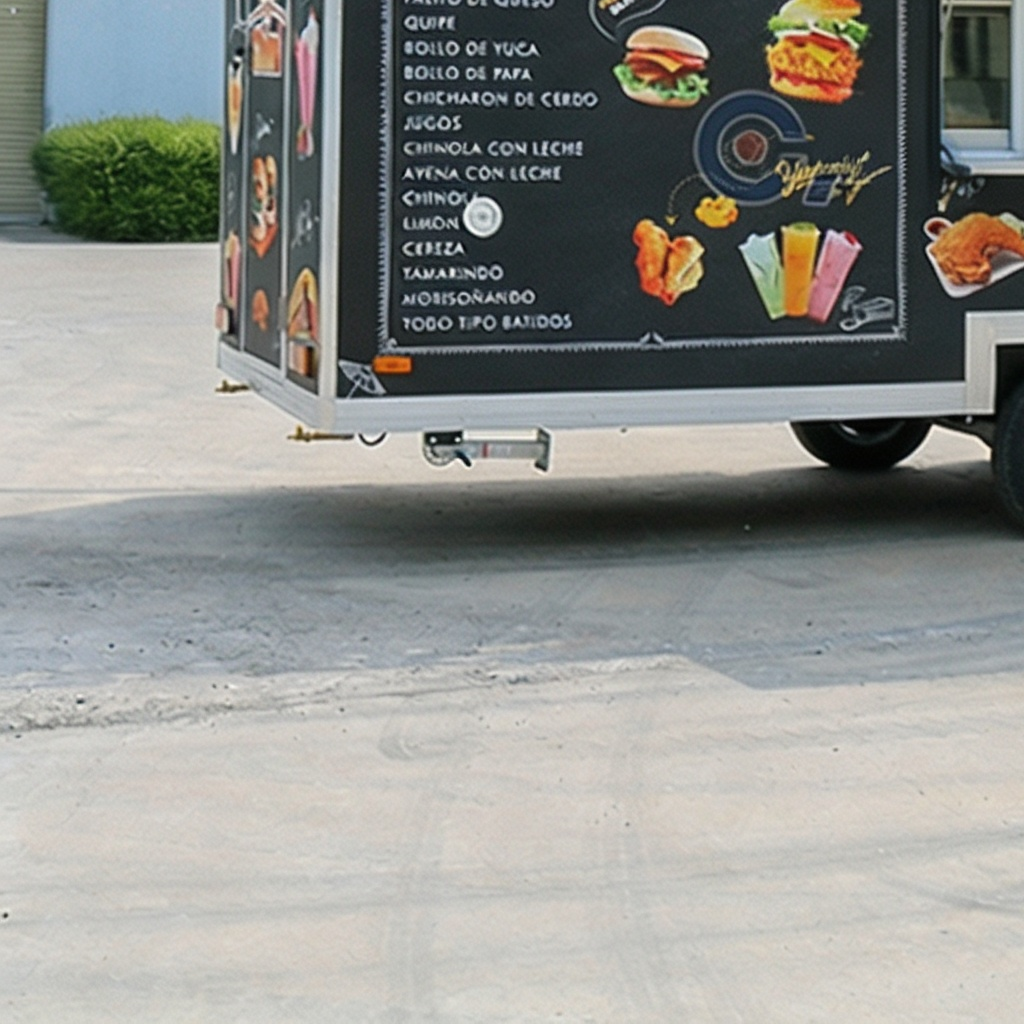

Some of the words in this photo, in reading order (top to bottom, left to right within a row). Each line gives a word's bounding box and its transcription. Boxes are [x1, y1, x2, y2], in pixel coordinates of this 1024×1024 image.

[404, 40, 459, 56] BOLLO
[465, 41, 487, 56] DE
[494, 42, 541, 57] YUCA
[404, 66, 460, 81] BOLLO
[465, 66, 486, 81] DE
[514, 92, 535, 107] DE
[540, 92, 599, 108] CERDO
[487, 140, 528, 156] CON
[532, 141, 585, 157] LECHE
[401, 166, 460, 181] AVENA
[465, 165, 506, 182] CON
[510, 166, 562, 182] LECHE
[403, 315, 453, 332] TODO
[458, 314, 497, 331] TIPO
